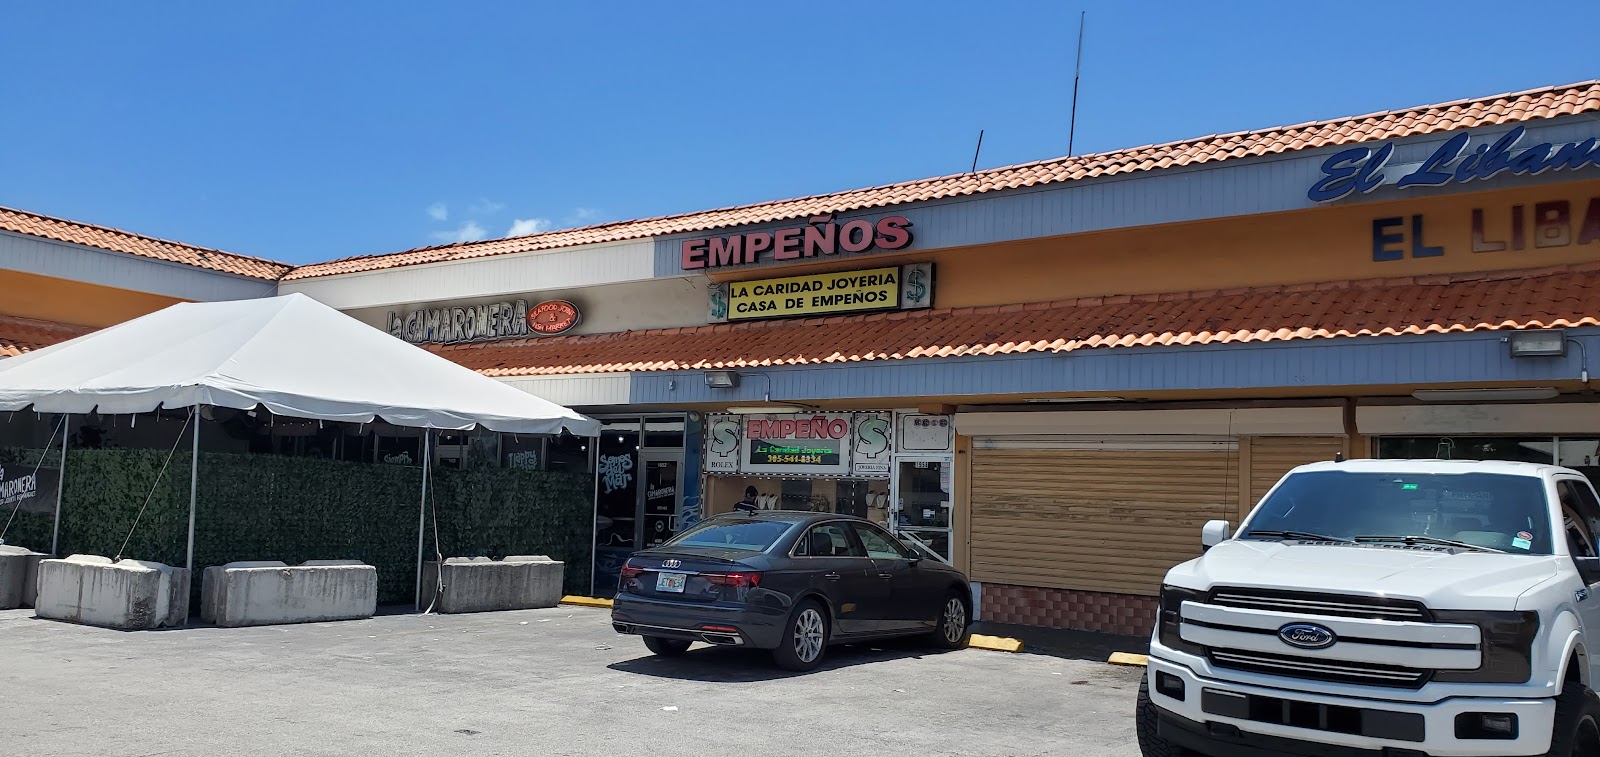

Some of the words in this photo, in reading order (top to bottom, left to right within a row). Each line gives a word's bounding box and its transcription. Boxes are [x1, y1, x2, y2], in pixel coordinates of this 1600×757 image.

[1307, 142, 1395, 202] El
[1397, 125, 1600, 189] Liban
[681, 213, 913, 270] EMPEÑOS
[1372, 213, 1444, 262] EL
[731, 286, 749, 299] LA
[753, 280, 823, 296] CARIDAD
[827, 273, 896, 291] JOYERIA
[530, 304, 558, 320] SEAFOOD
[736, 300, 777, 313] CASA
[785, 298, 804, 310] DE
[812, 290, 888, 308] EMPEÑOS
[405, 300, 528, 343] CAMARONERA
[545, 318, 571, 331] MARKET
[549, 313, 557, 322] &
[746, 415, 848, 439] EMPEÑO
[769, 445, 799, 454] Caridad
[711, 461, 734, 469] ROLEX
[602, 473, 633, 495] Mar
[1291, 628, 1319, 642] Ford
